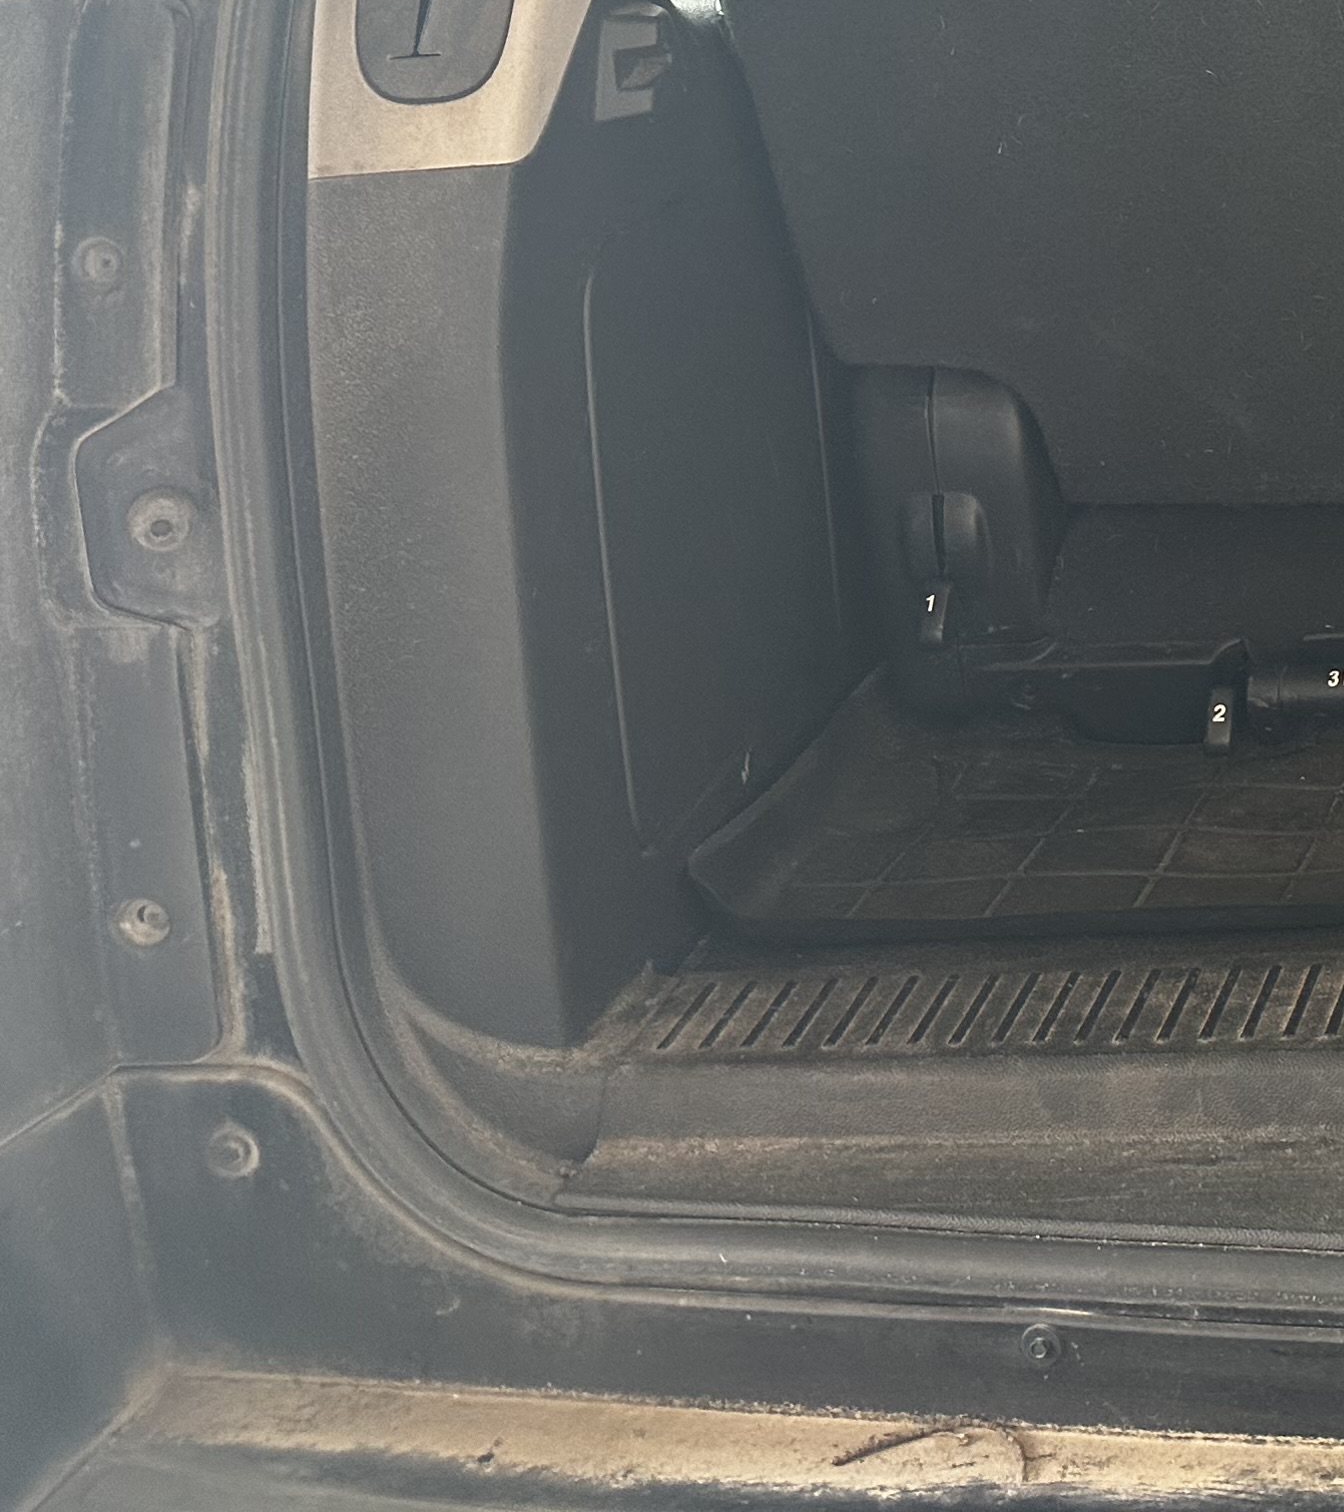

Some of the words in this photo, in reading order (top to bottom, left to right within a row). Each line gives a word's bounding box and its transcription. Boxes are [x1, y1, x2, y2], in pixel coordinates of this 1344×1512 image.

[925, 594, 935, 612] 1
[1327, 670, 1340, 687] 3
[1212, 704, 1227, 722] 2
